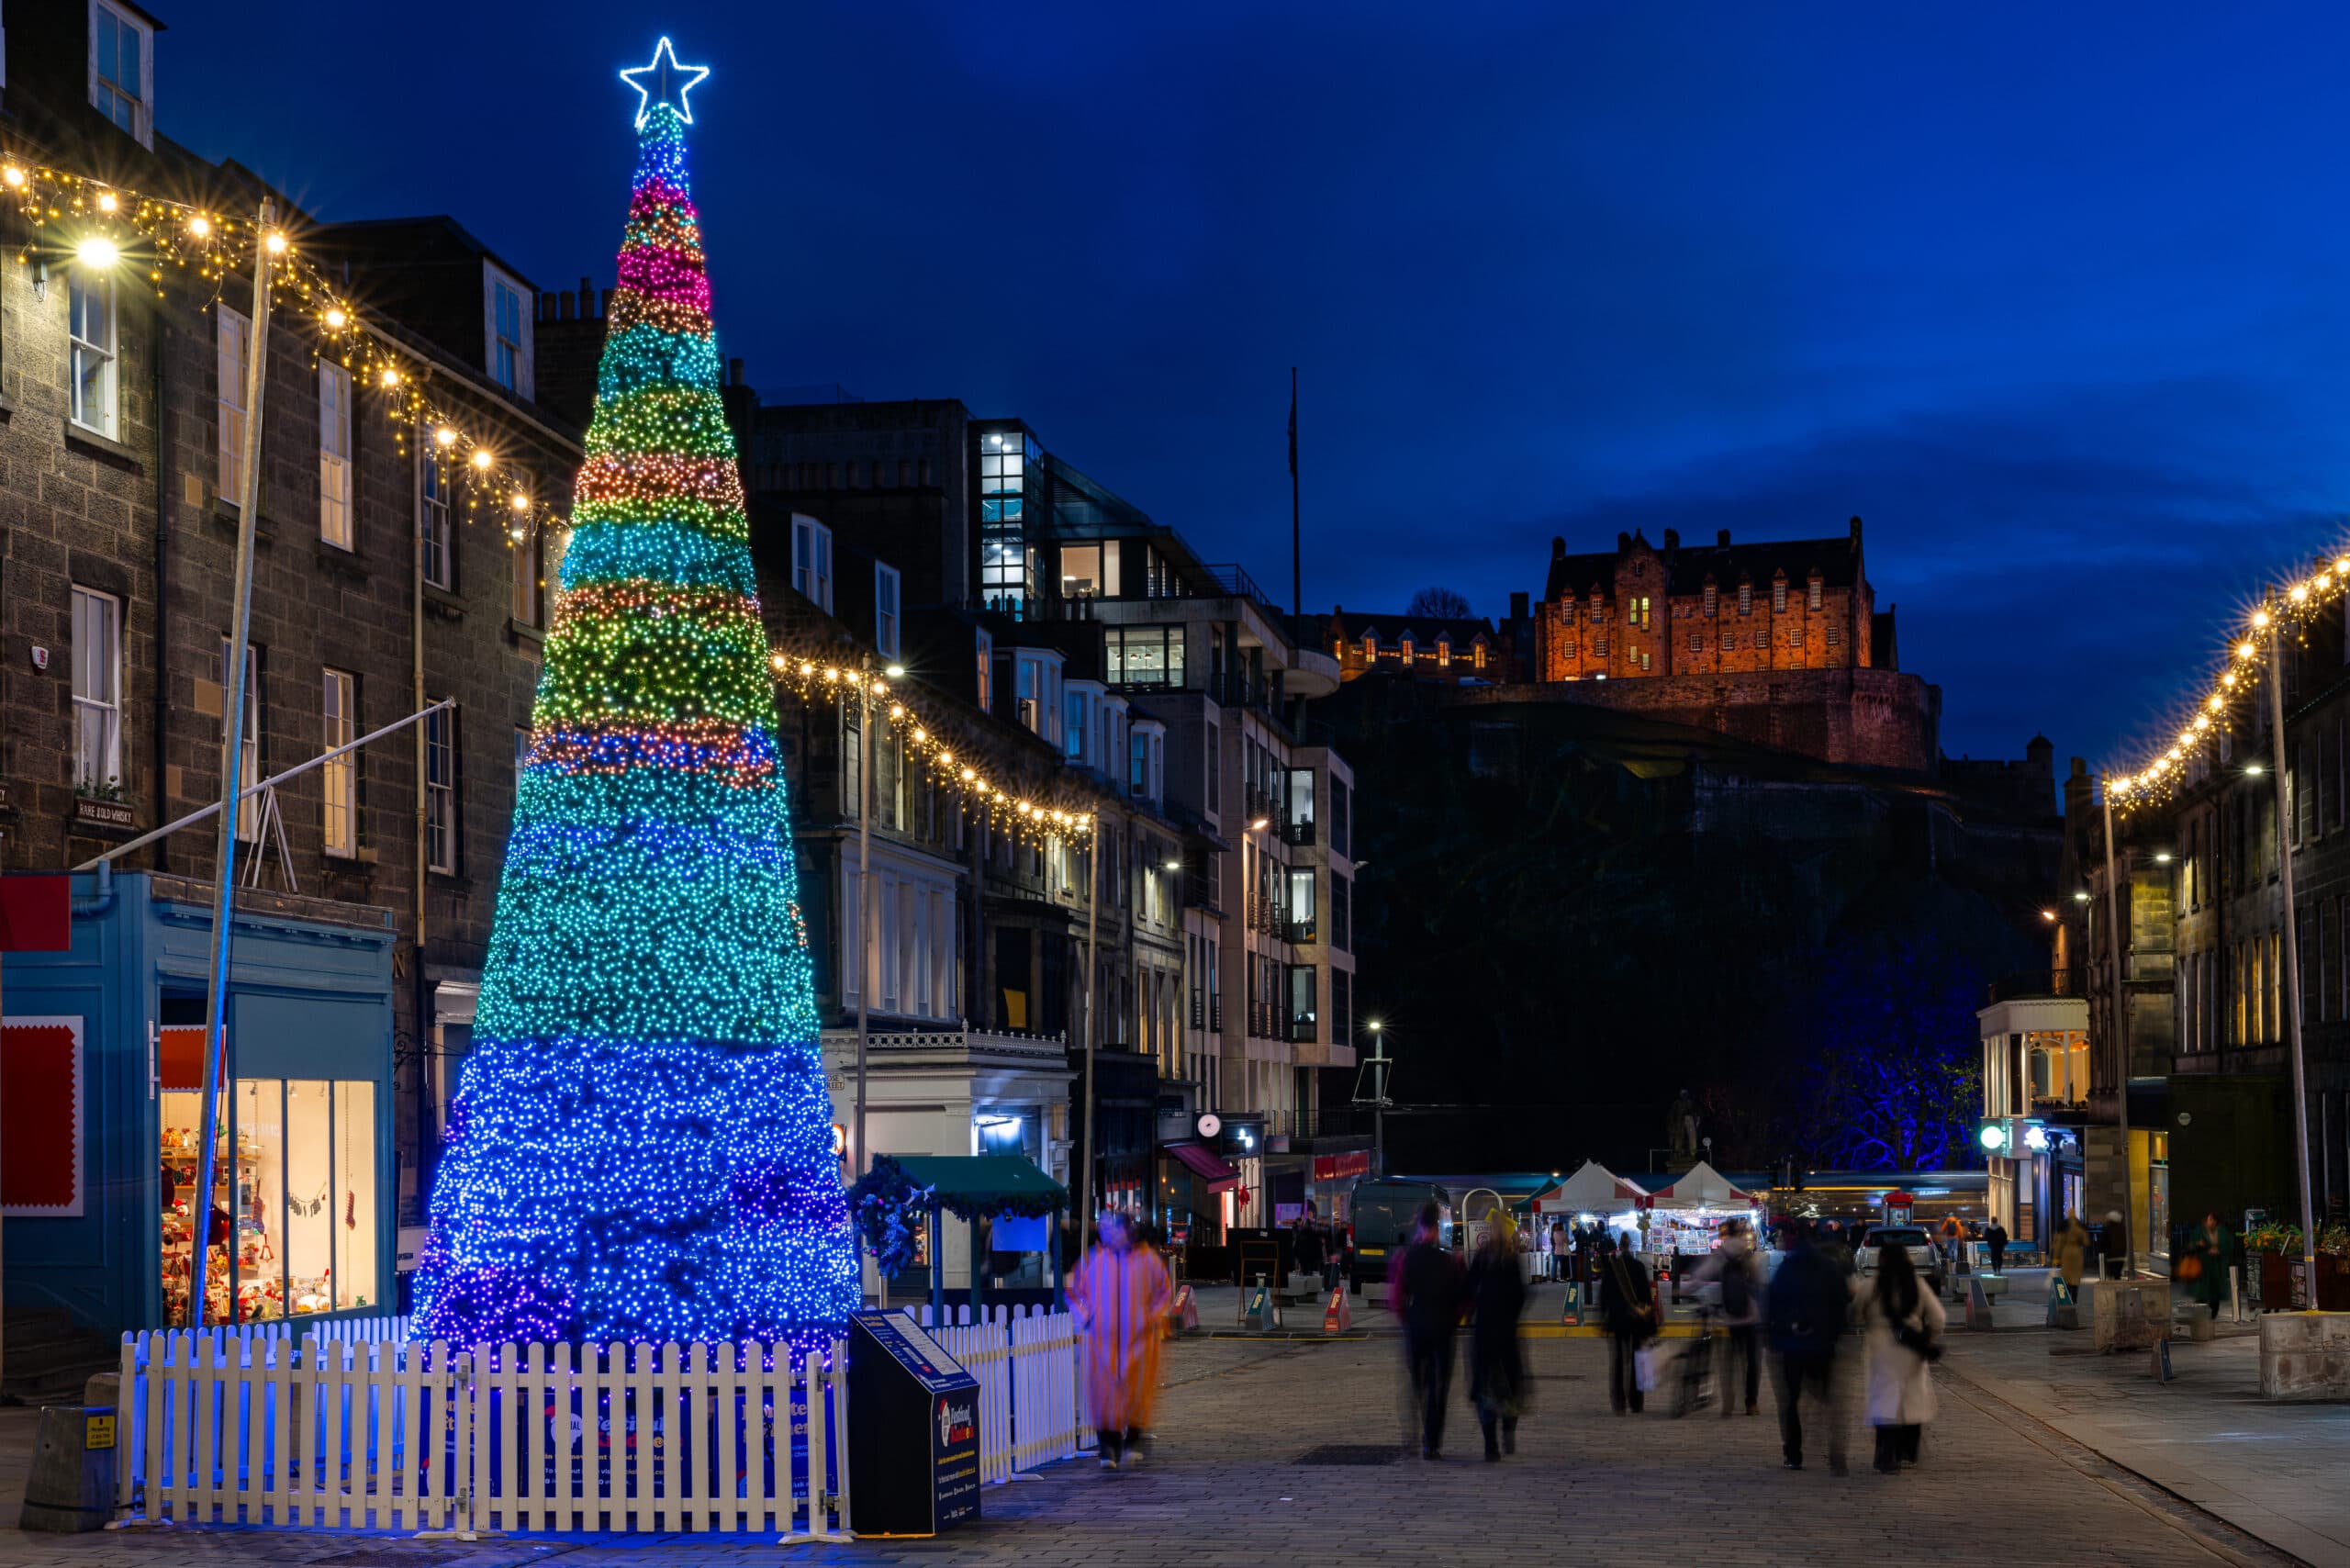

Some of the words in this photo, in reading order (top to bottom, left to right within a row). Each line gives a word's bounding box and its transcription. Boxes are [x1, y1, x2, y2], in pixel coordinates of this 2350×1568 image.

[80, 803, 95, 817] RARE
[100, 808, 111, 820] OLD
[111, 809, 131, 823] WHISKY
